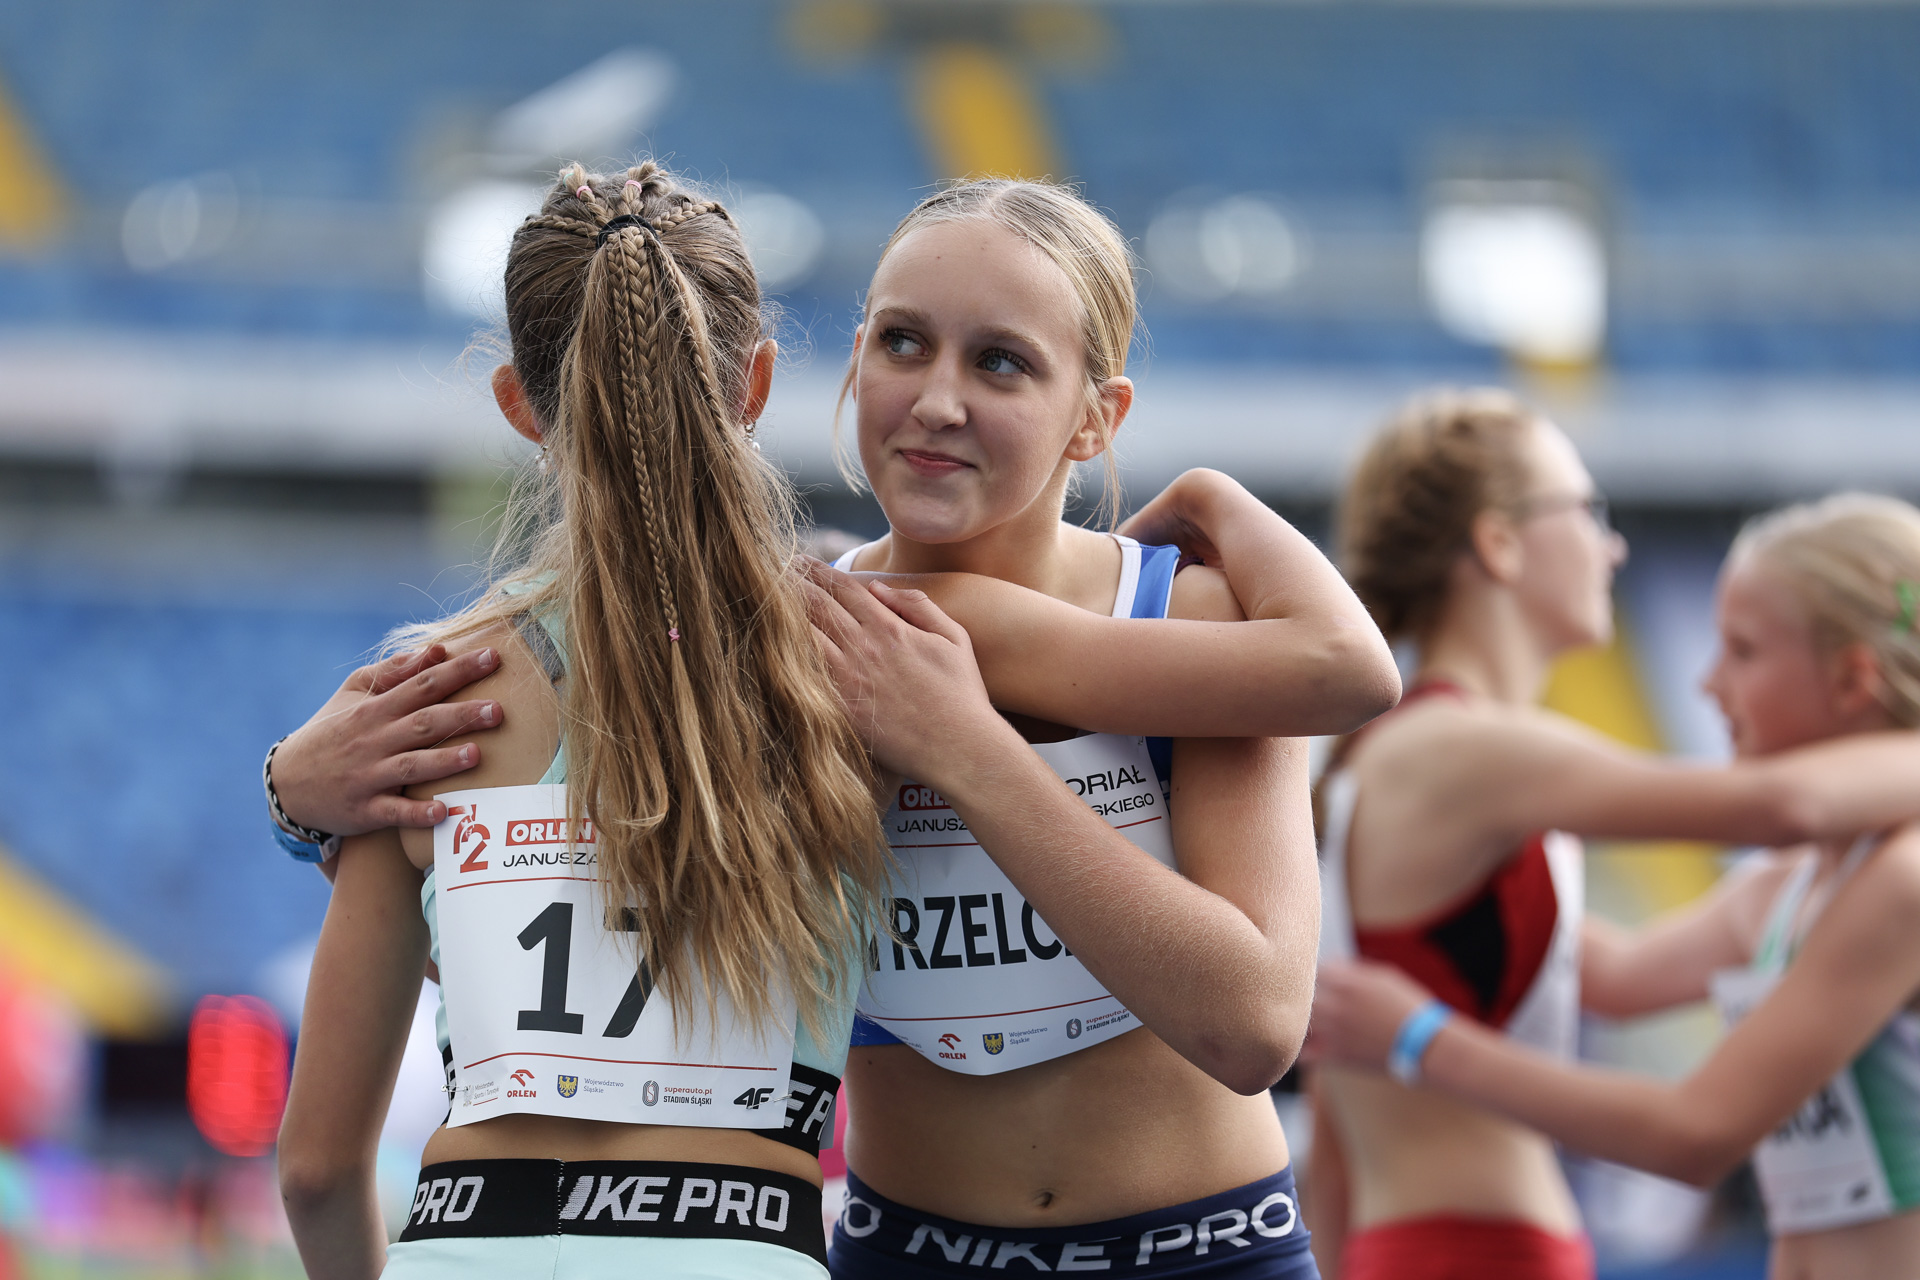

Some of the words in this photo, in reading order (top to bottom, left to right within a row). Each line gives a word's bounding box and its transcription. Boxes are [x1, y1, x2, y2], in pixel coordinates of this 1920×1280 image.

[903, 787, 950, 808] ORL
[868, 893, 1073, 972] RZELC
[517, 902, 668, 1039] 17
[1009, 1027, 1048, 1038] Województwo
[1086, 1020, 1110, 1032] STADION
[938, 1052, 967, 1060] ORLEN
[583, 1078, 625, 1088] Województwo
[664, 1086, 713, 1095] superauto.pl
[506, 1090, 537, 1098] ORLEN
[663, 1095, 690, 1104] STADION
[690, 1095, 712, 1106] ŚLĄSKI
[733, 1087, 774, 1110] 4F
[403, 1175, 485, 1230] PRO
[673, 1177, 790, 1232] PRO
[904, 1223, 1121, 1272] NIKE
[1135, 1192, 1297, 1266] PRO
